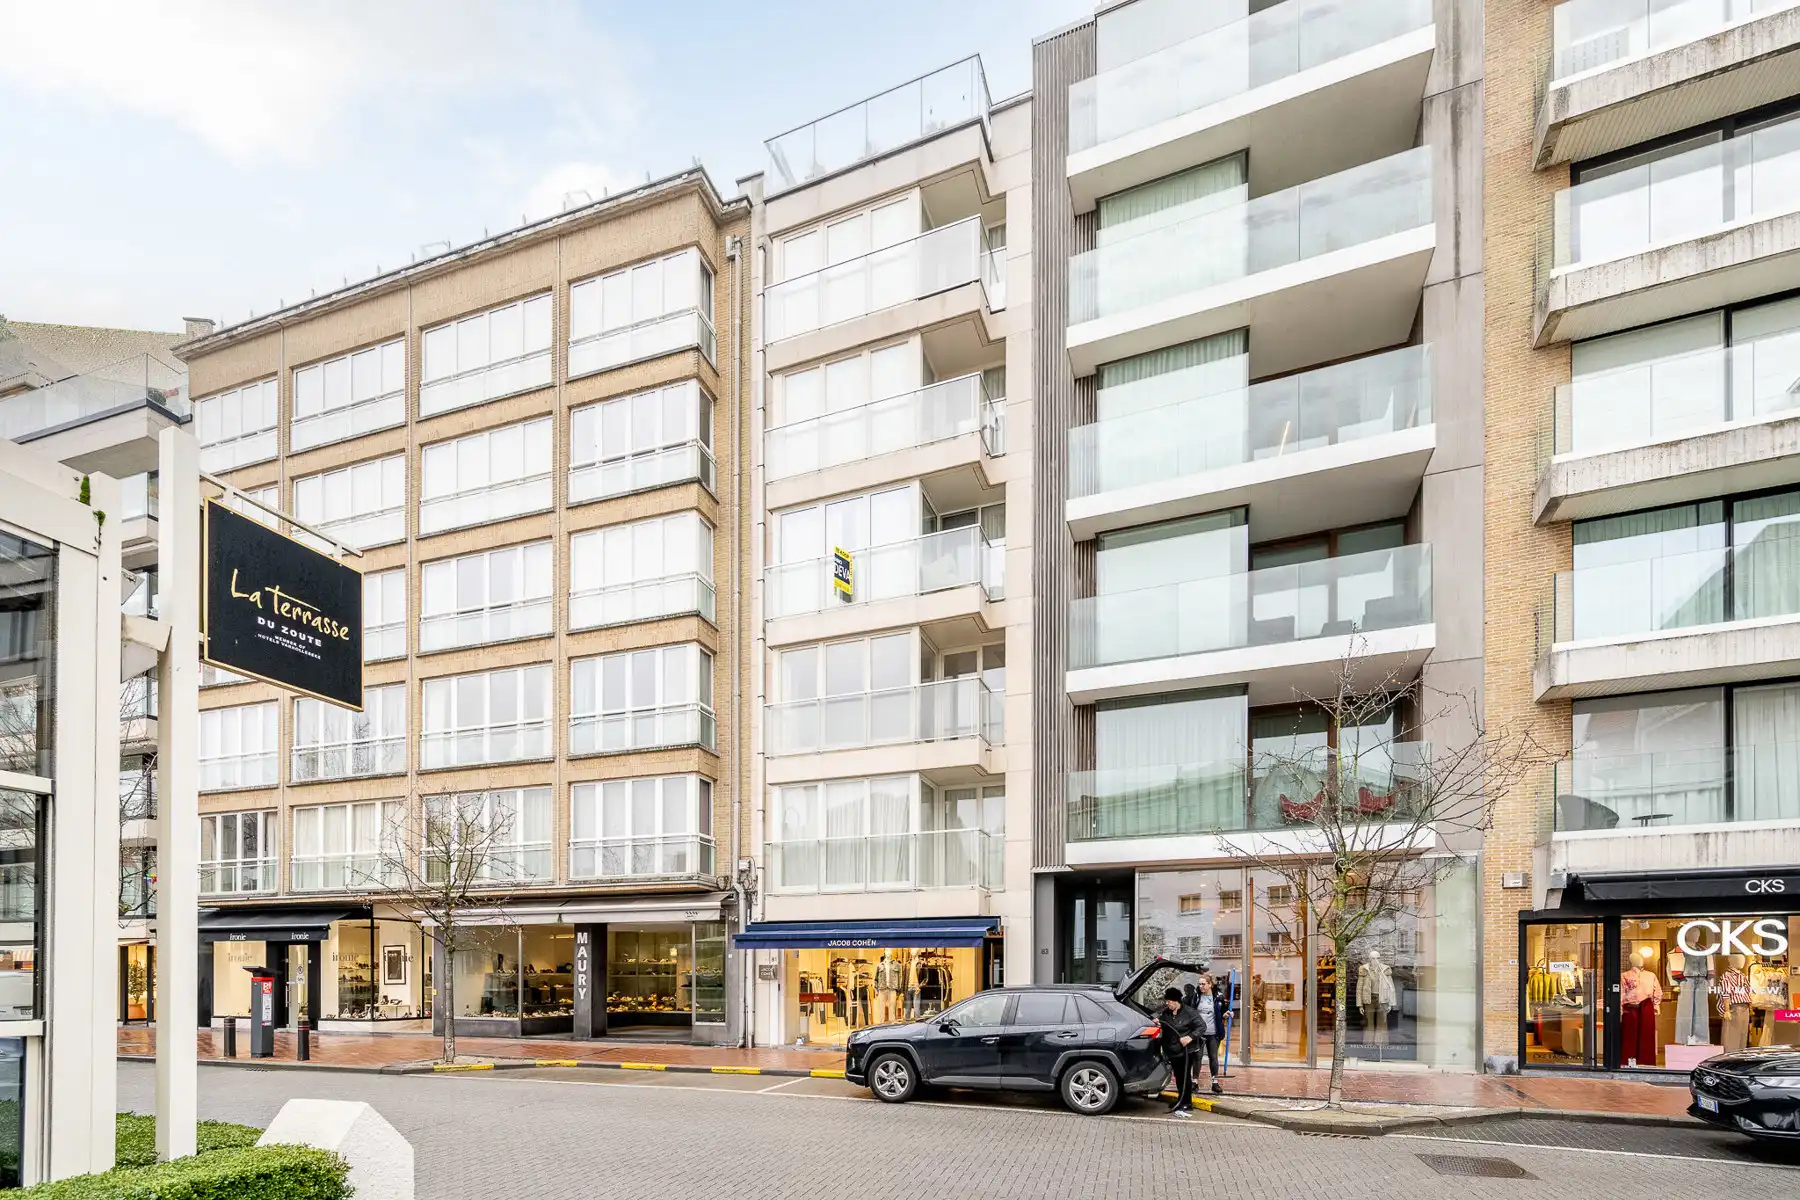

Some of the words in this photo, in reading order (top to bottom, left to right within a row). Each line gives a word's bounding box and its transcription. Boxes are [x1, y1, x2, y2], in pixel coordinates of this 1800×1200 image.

[231, 568, 262, 609] La
[257, 616, 275, 629] DU
[281, 625, 322, 647] ZOUTE
[1745, 879, 1785, 893] CKS
[1676, 919, 1789, 957] CKS
[576, 932, 588, 1000] MAURY
